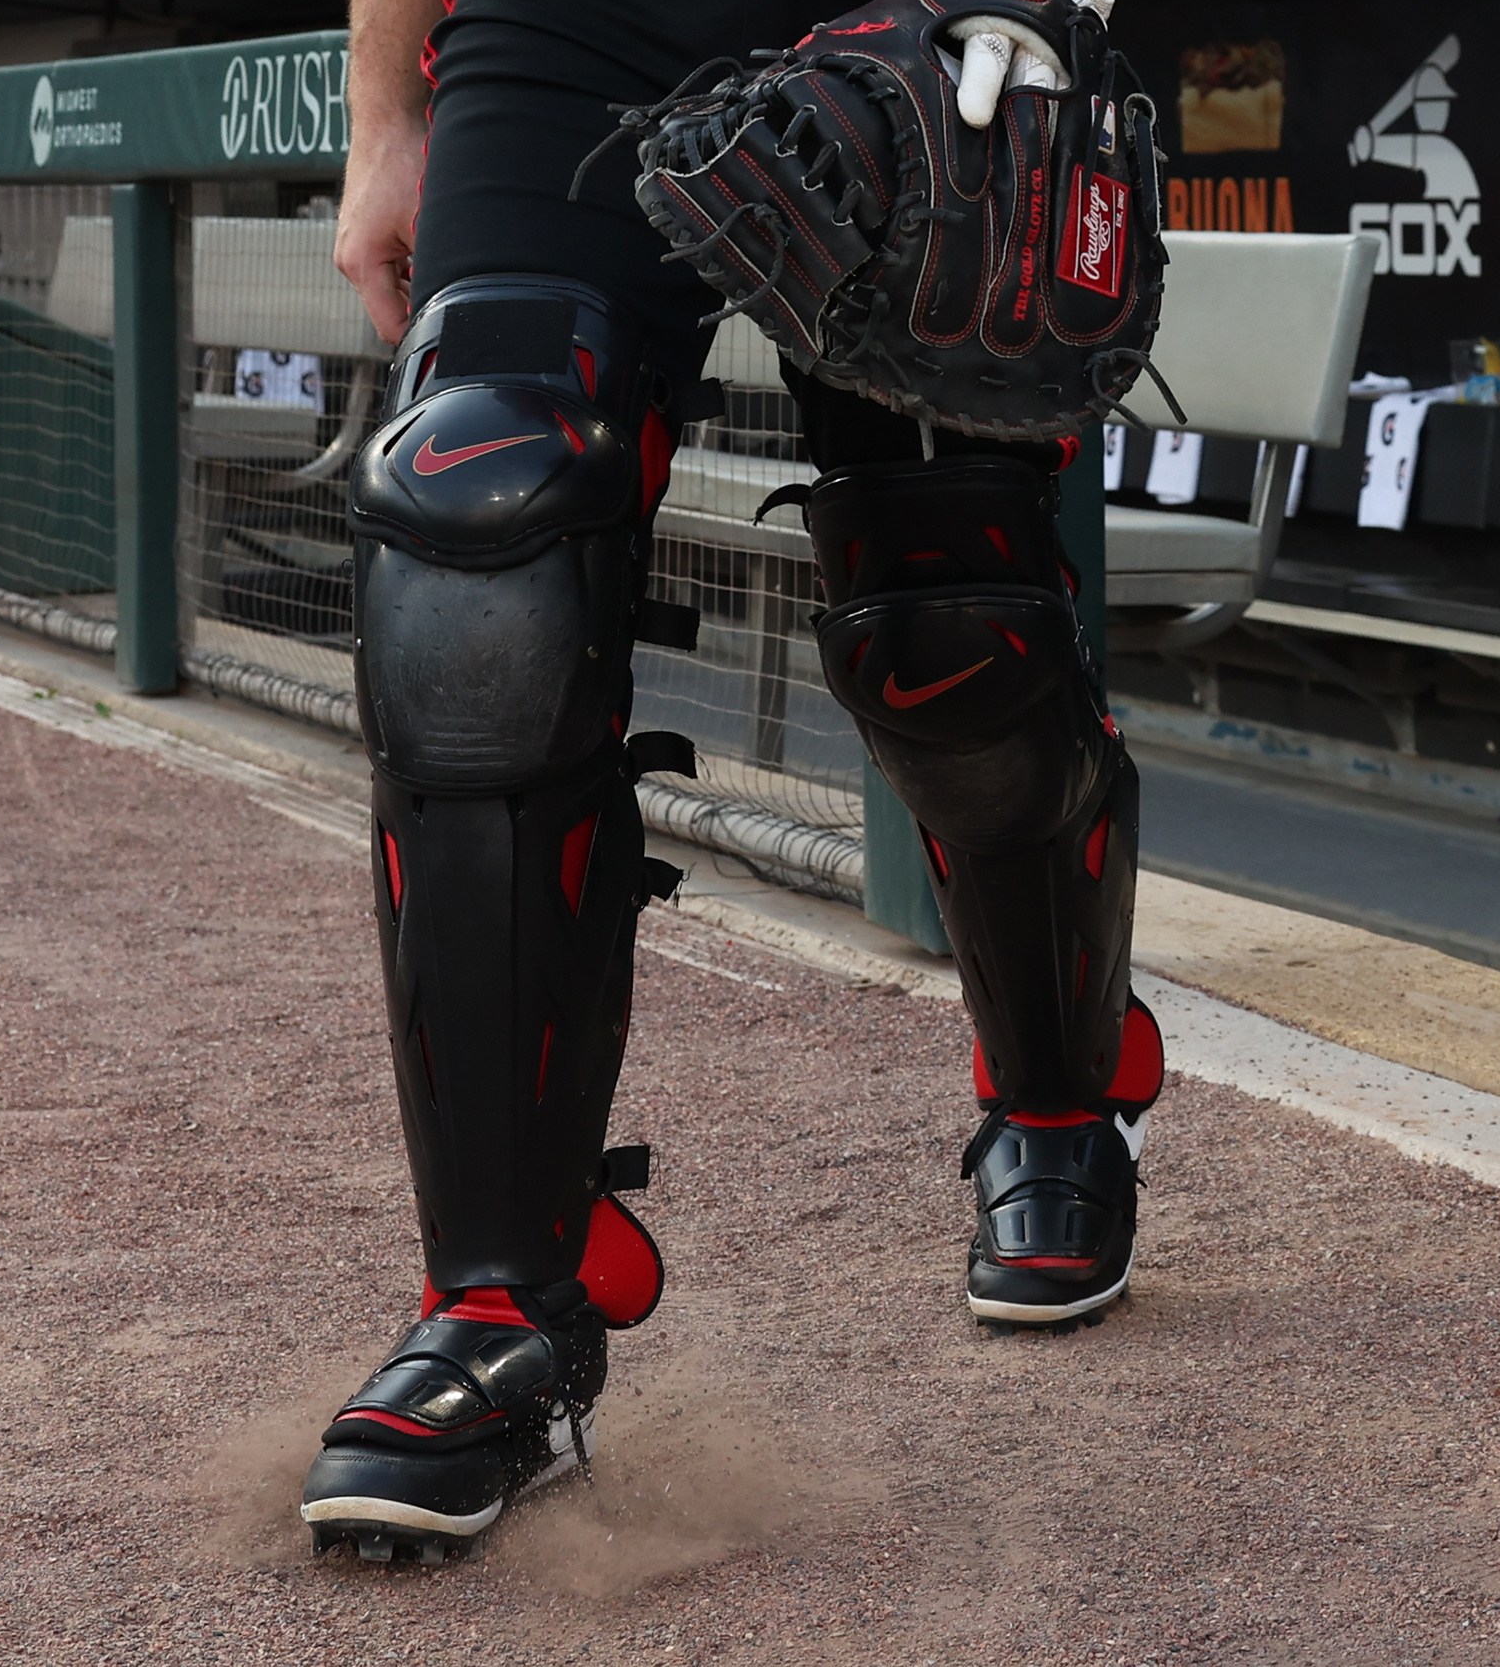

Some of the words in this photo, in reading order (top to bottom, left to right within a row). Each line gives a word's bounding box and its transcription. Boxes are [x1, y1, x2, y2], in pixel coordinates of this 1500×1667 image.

[250, 51, 352, 155] RUSH
[1025, 195, 1043, 240] GLOVE
[1079, 181, 1110, 281] Rawlings
[1350, 203, 1481, 277] SOX
[1018, 243, 1036, 288] GOLD
[1012, 290, 1035, 322] THE
